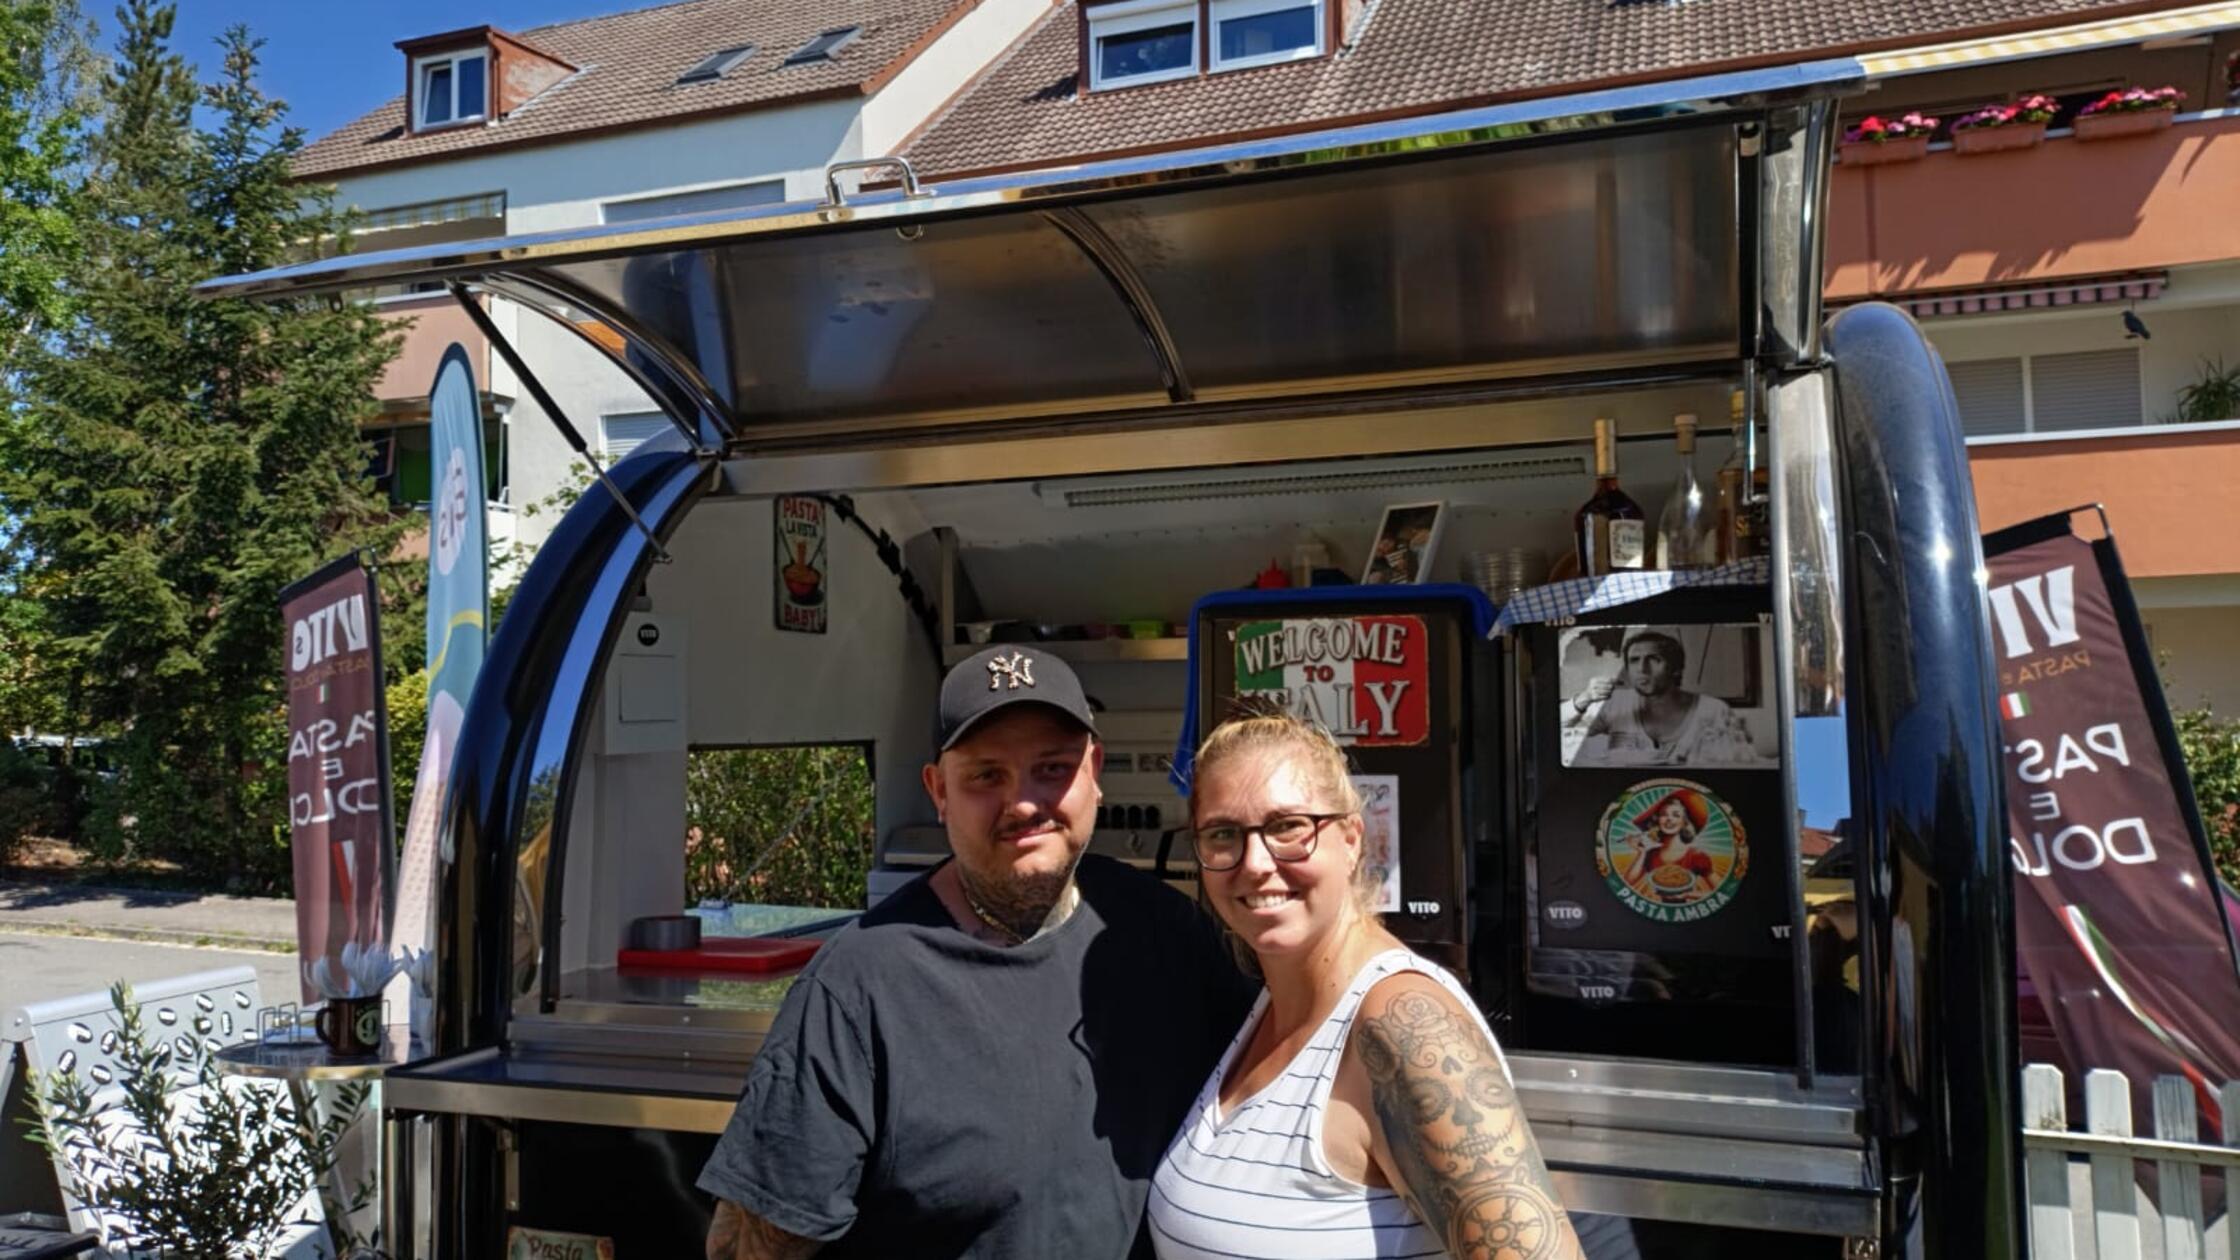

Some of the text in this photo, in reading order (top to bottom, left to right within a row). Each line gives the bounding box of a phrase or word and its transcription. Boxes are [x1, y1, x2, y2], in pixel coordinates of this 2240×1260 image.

[1241, 621, 1407, 675] WELCOME
[1303, 664, 1334, 682] TO
[1240, 680, 1410, 736] ALY
[1408, 902, 1440, 914] VITO
[1549, 907, 1583, 919] VITO
[1617, 887, 1730, 922] PASTA AMBRA
[1580, 986, 1614, 999] VITO
